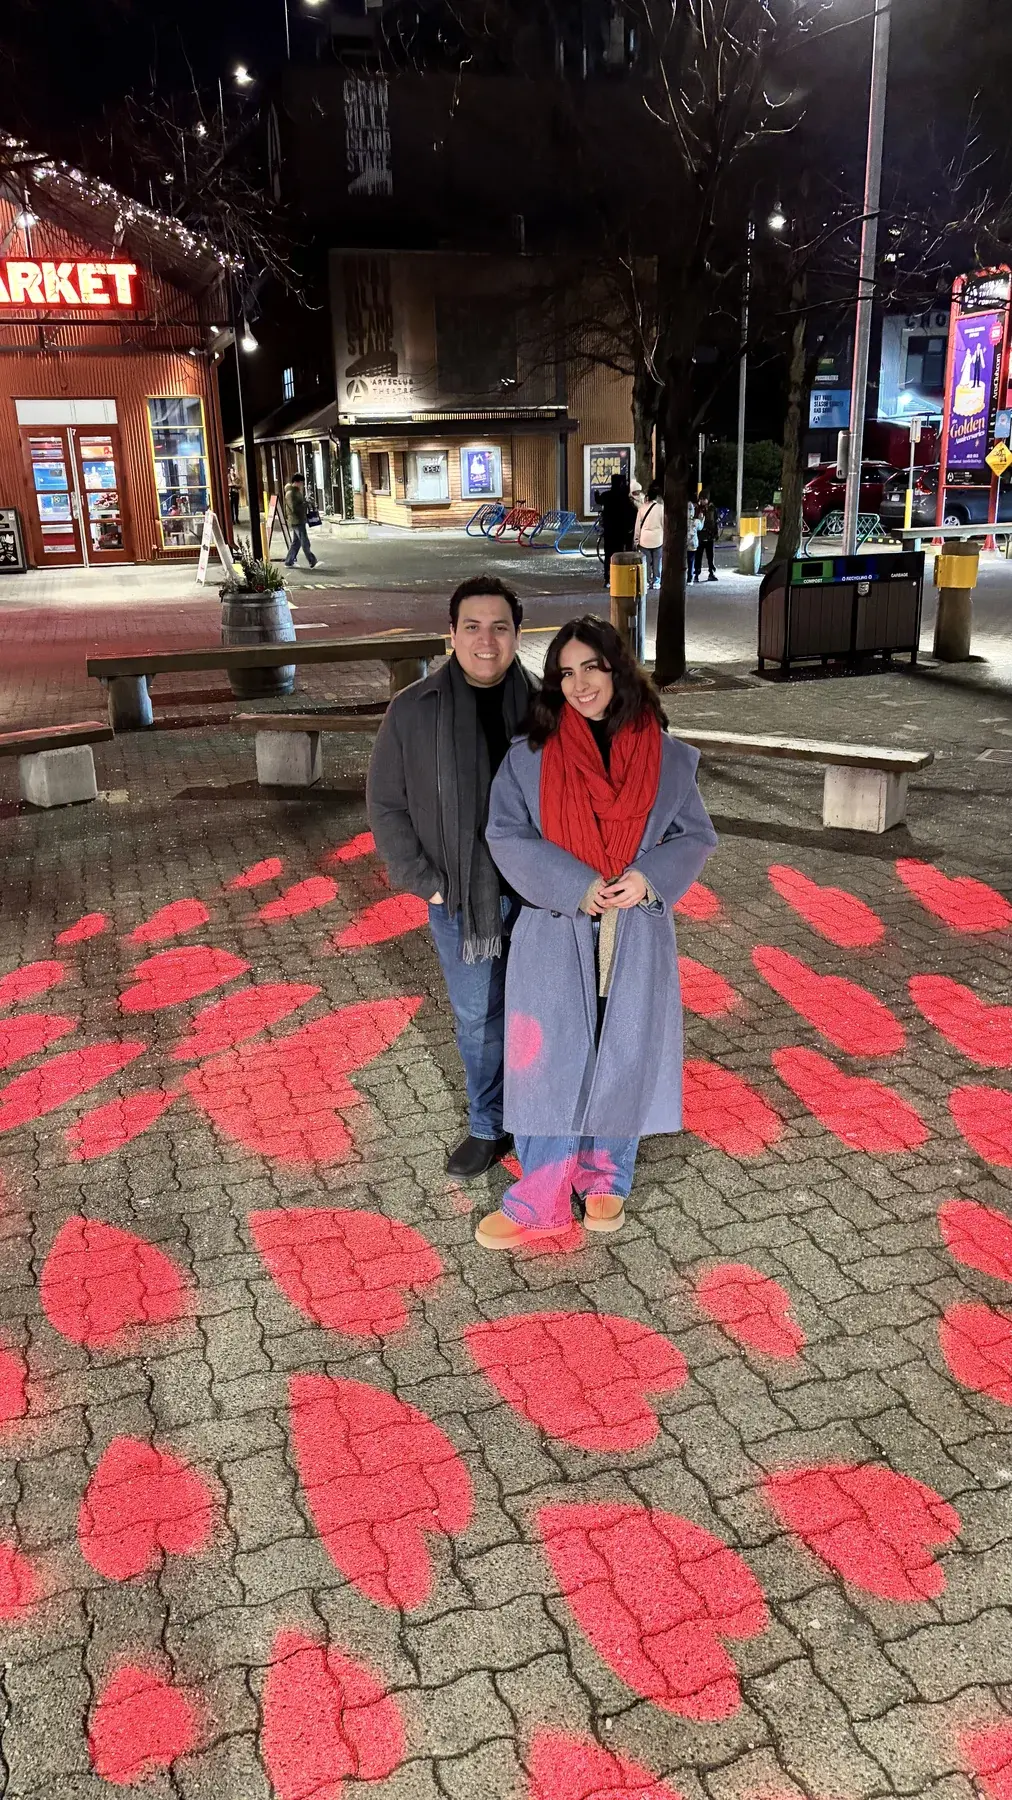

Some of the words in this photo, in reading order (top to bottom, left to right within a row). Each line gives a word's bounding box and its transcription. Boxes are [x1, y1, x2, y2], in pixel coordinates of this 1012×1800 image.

[950, 417, 985, 438] Golden
[591, 458, 620, 467] COME
[423, 465, 441, 473] OPEN
[591, 476, 612, 484] AWA
